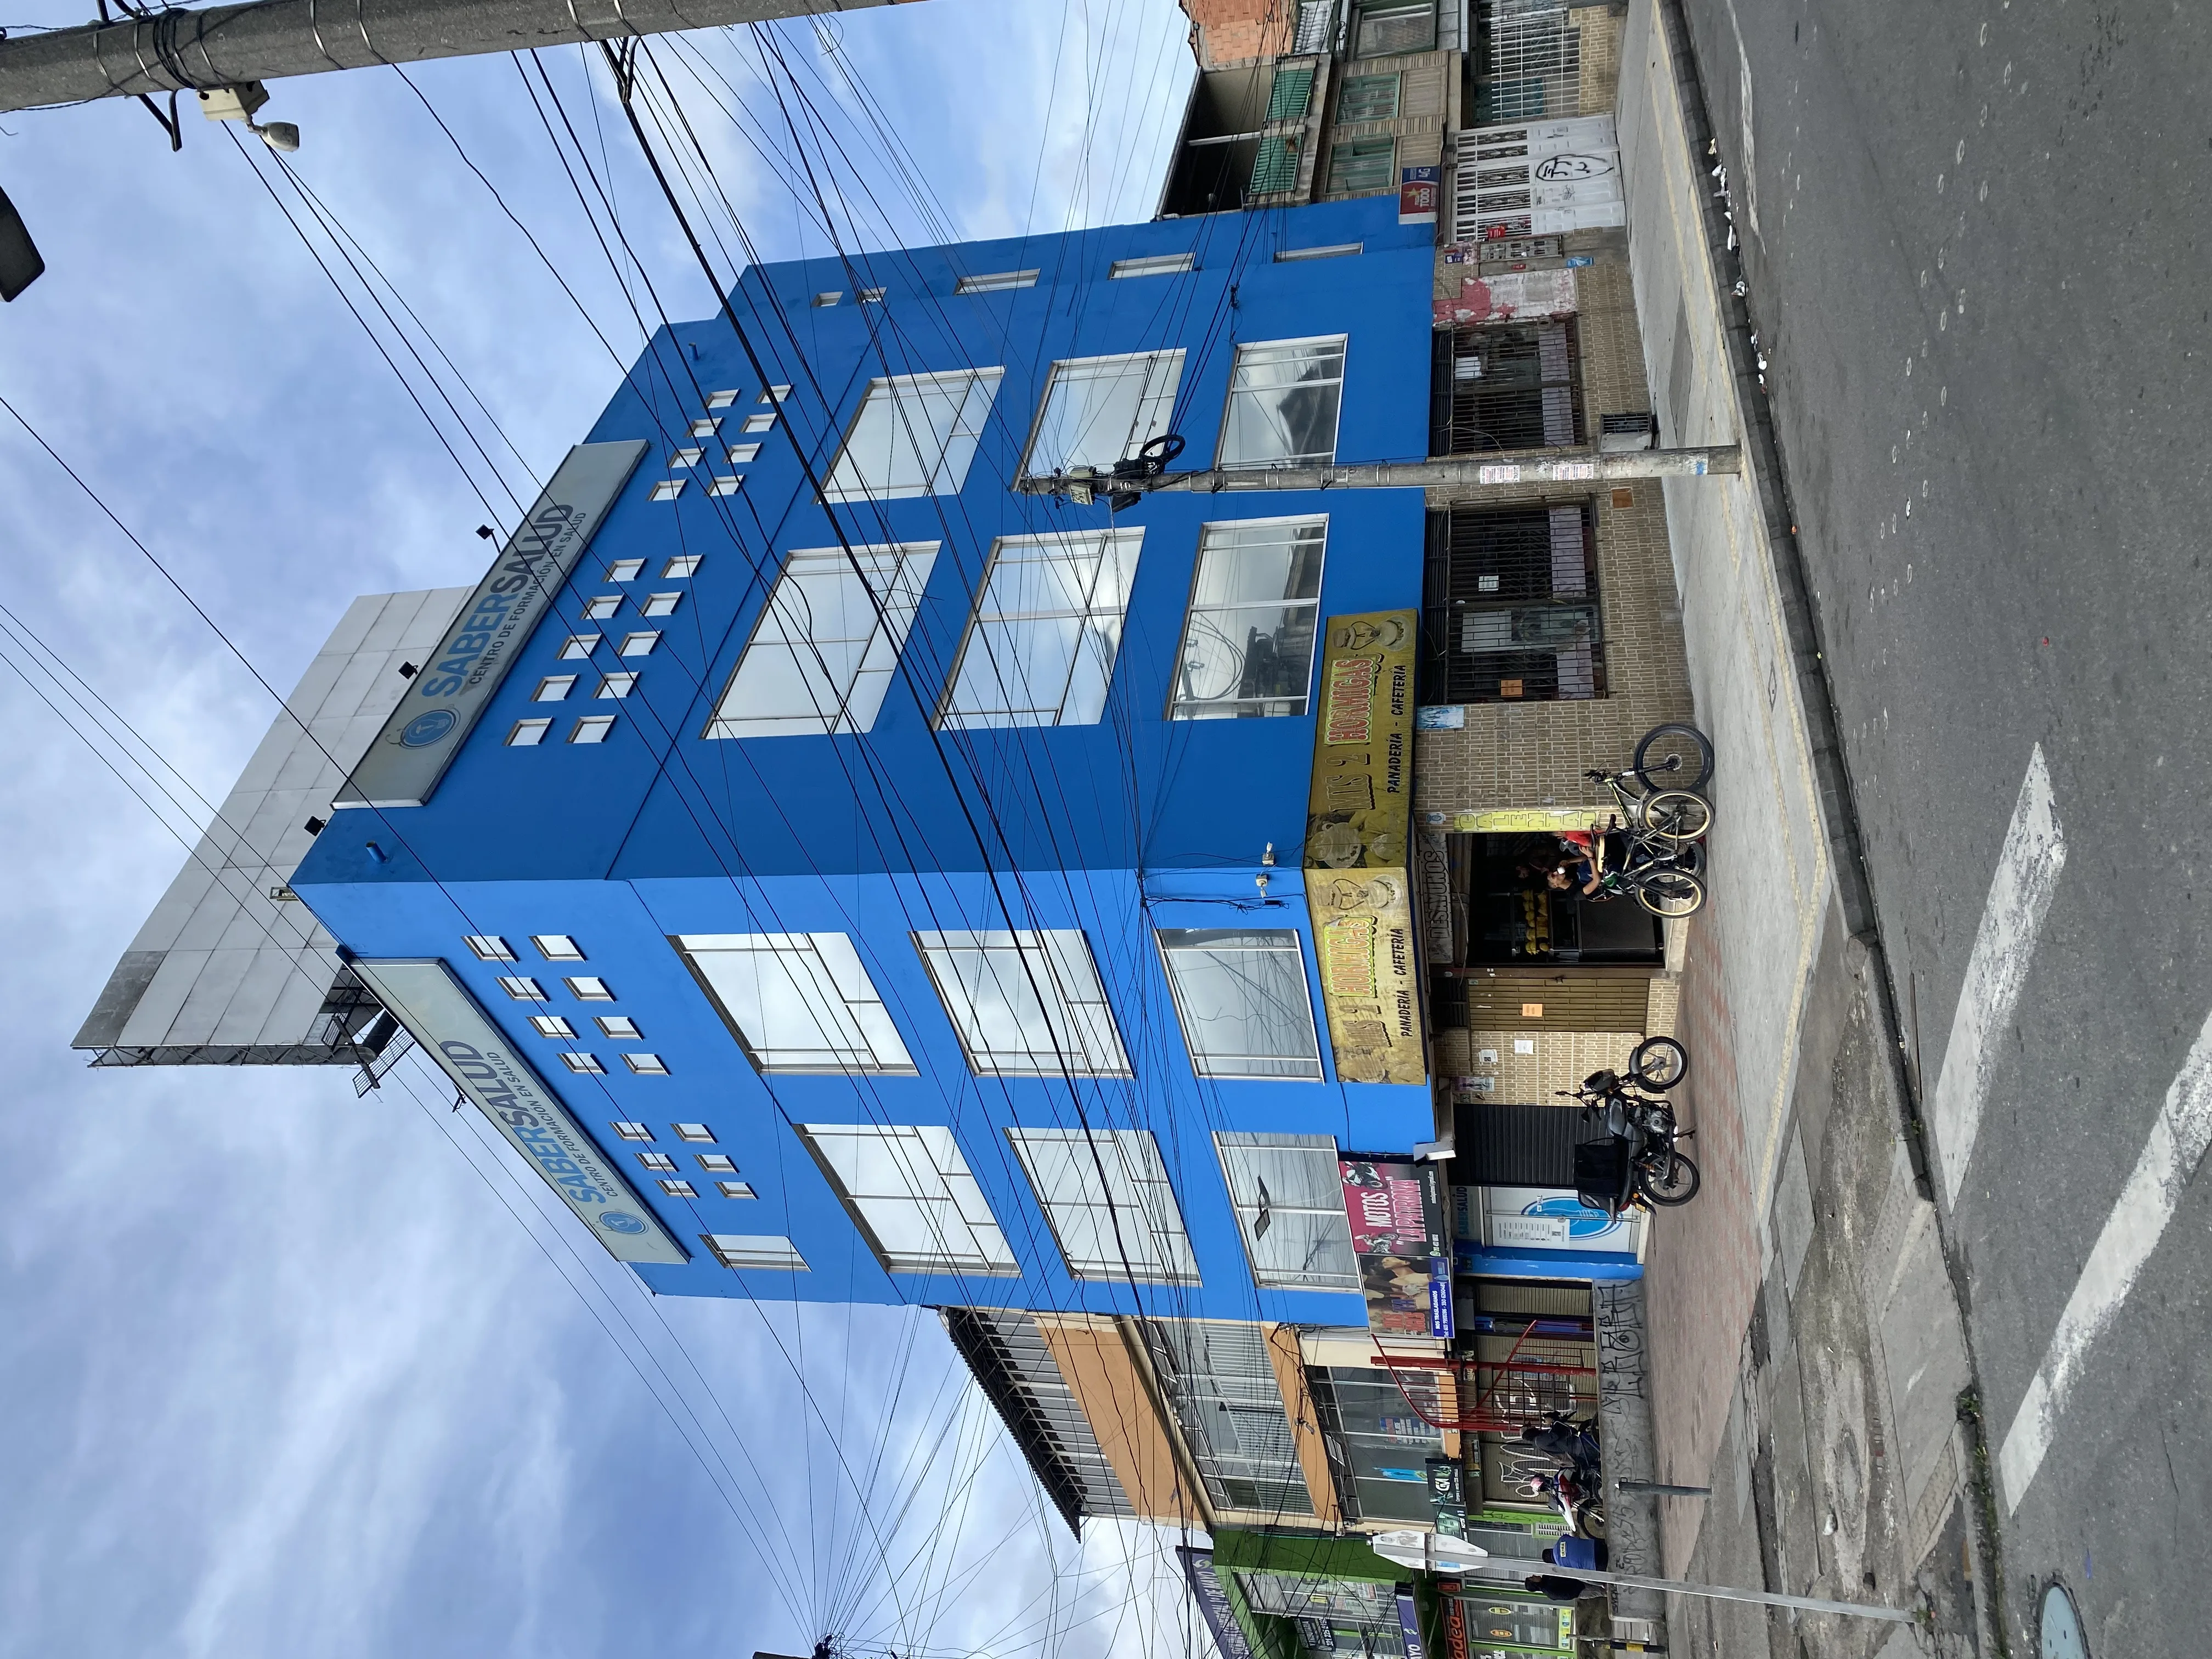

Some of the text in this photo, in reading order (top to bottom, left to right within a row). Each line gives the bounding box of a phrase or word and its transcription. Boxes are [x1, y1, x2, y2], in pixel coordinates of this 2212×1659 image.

[1418, 168, 1431, 177] 4G
[1419, 188, 1430, 207] TODO
[421, 504, 574, 697] SABERSALUD
[469, 512, 586, 685] CENTRO DE FORMACIÓN EN SALUD
[1389, 664, 1407, 716] CAFETERÍA
[1325, 657, 1374, 811] MIS 2 HORMIGAS
[1386, 732, 1403, 794] PANADERÍA
[1423, 850, 1449, 939] DESAYUNOS
[1325, 917, 1373, 995] HORMIGAS
[1387, 928, 1407, 975] CAFETERÍA
[1339, 1005, 1381, 1015] 2
[1393, 990, 1413, 1037] PANADERÍA
[439, 1041, 606, 1203] SABERSALUD
[486, 1052, 618, 1197] CENTRO DE FORMACIÓN EN SALUD
[1360, 1192, 1393, 1228] MOTOS
[1384, 1176, 1427, 1245] "LA PATRONA"
[1455, 1187, 1469, 1235] SABERSALUD
[1432, 1290, 1440, 1321] TRASLADAMOS
[1197, 1571, 1222, 1589] MAYO
